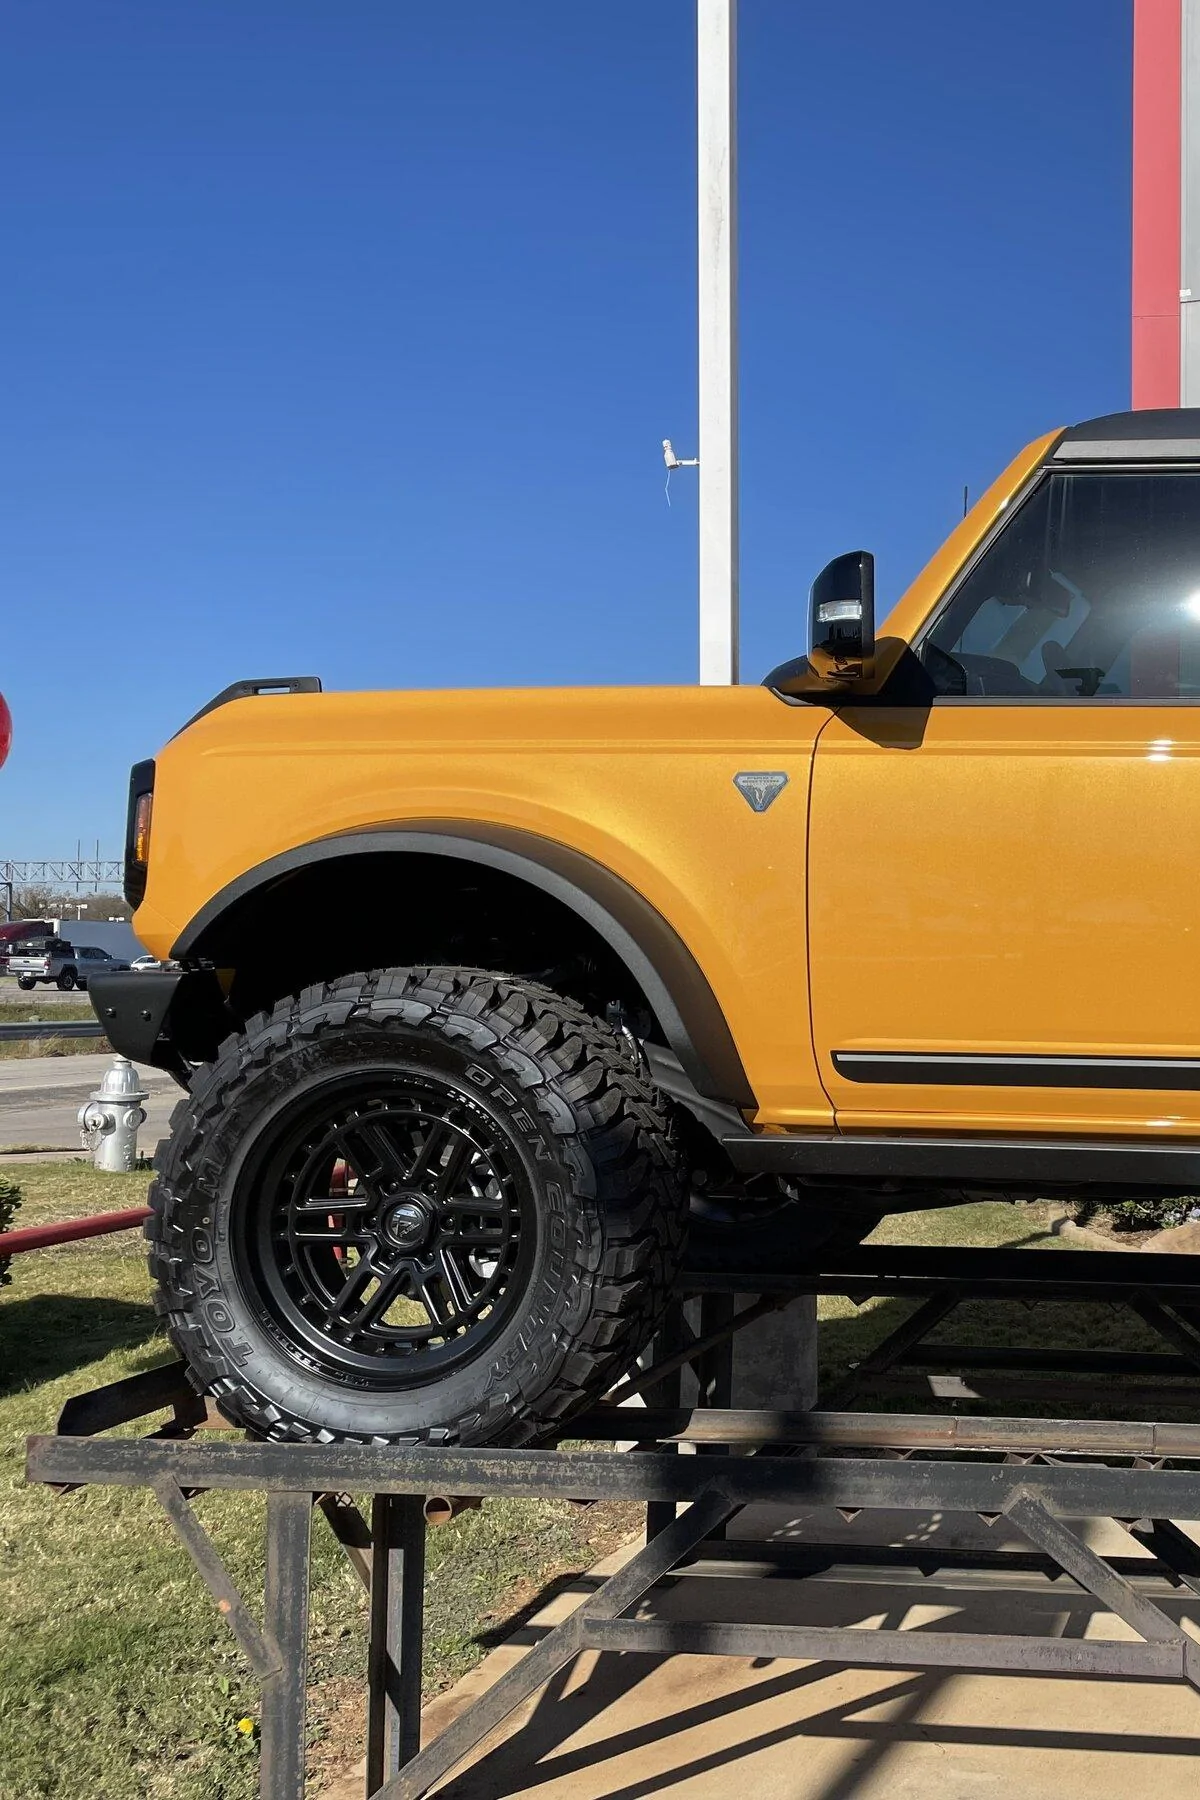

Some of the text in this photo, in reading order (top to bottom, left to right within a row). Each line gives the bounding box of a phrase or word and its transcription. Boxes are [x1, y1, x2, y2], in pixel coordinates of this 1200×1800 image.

[191, 1226, 255, 1368] TOYO
[464, 1063, 566, 1394] OPEN COUNTRY
